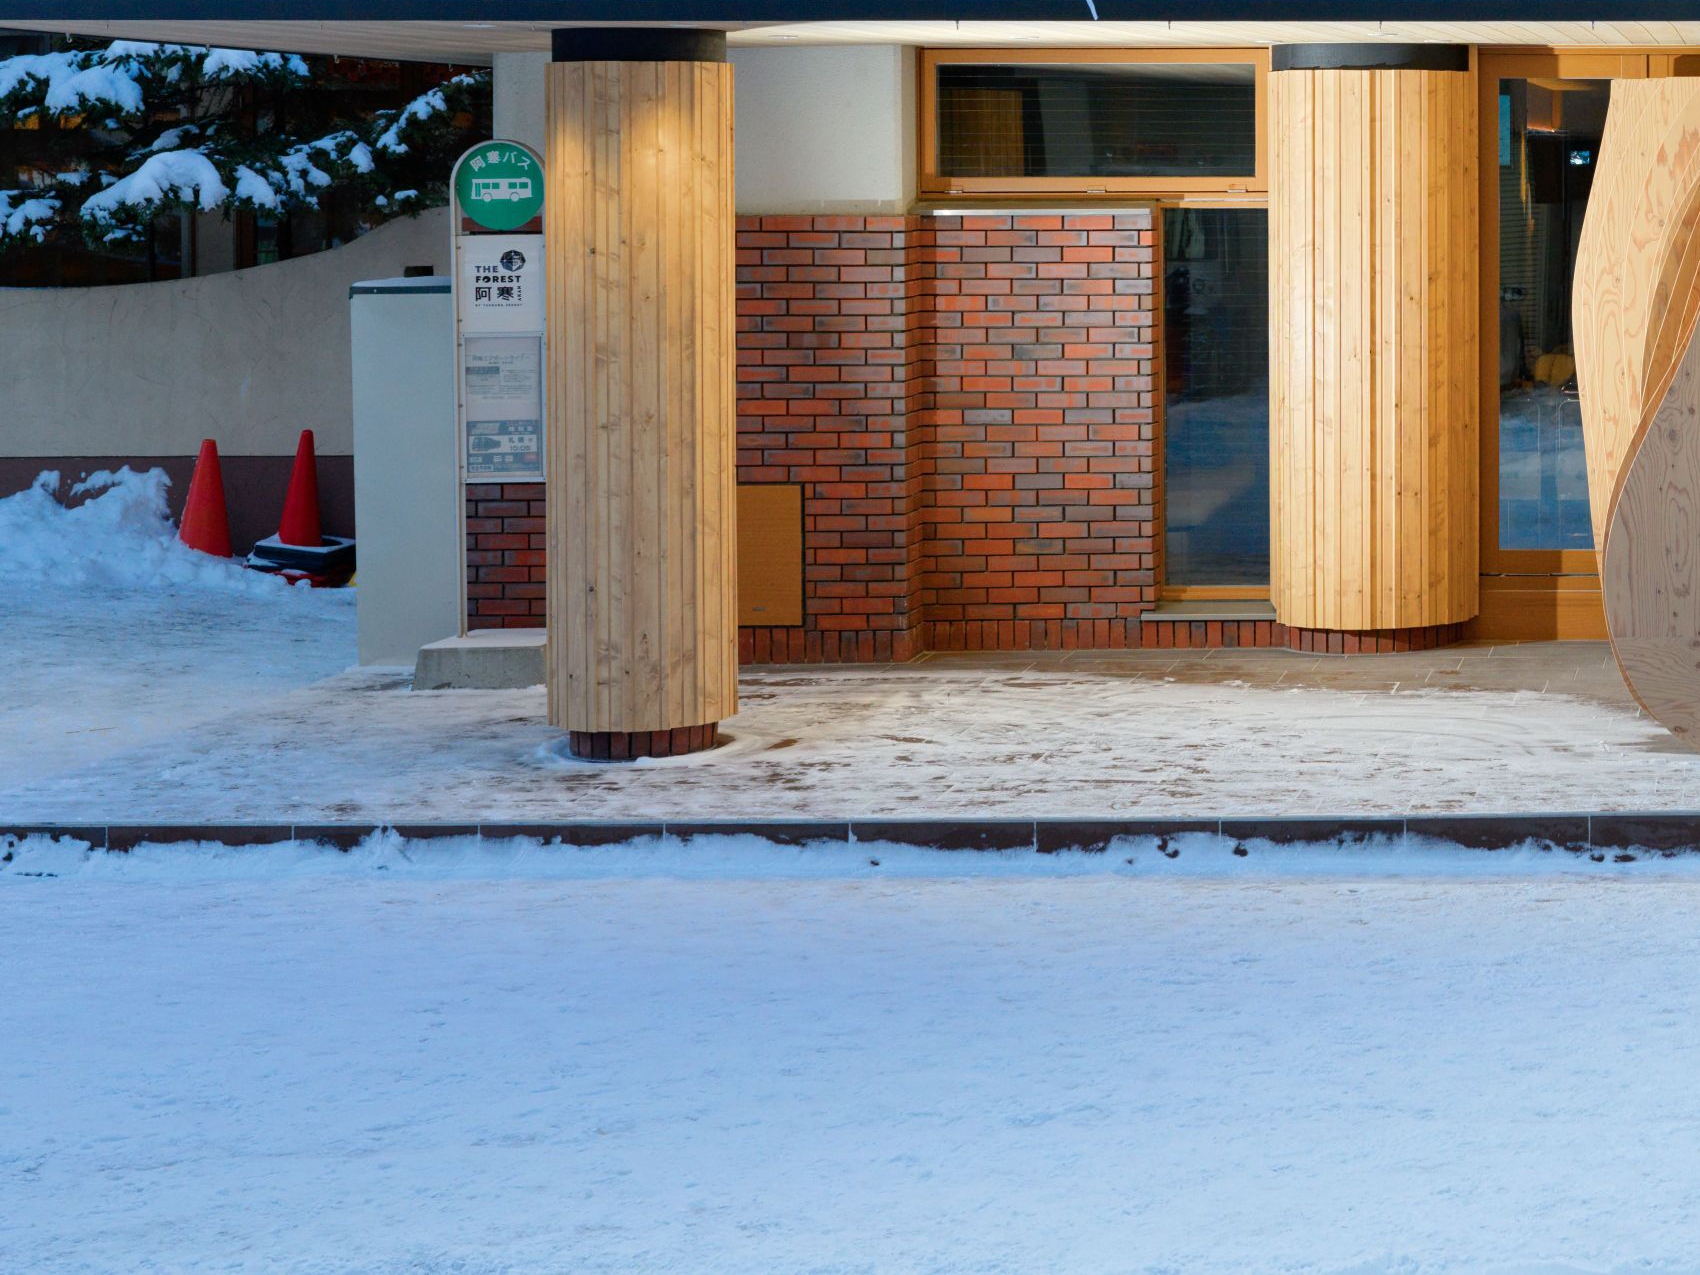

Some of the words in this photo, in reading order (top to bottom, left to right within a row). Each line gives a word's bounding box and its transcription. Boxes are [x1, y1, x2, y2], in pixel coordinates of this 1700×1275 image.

[469, 150, 531, 172] 阿寒バス
[474, 265, 499, 274] THE
[475, 275, 522, 284] FOREST
[475, 286, 515, 302] 阿寒
